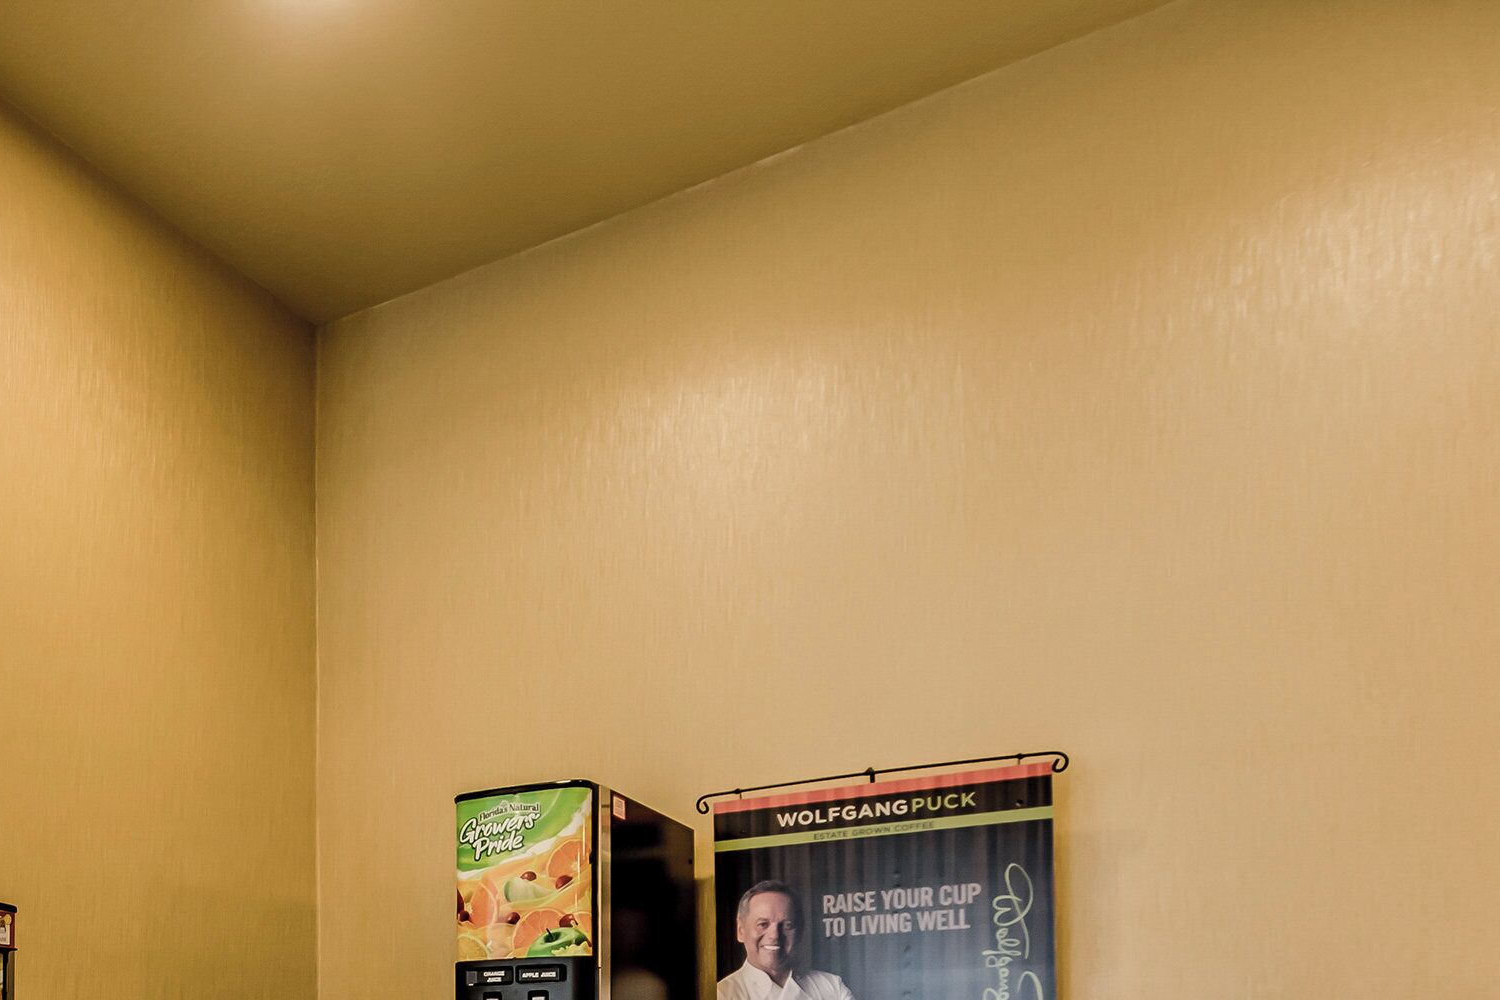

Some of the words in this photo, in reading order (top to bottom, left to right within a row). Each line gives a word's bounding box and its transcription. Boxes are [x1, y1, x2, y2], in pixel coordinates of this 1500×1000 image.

[509, 802, 541, 814] Natural
[473, 830, 525, 862] Pride
[813, 830, 849, 842] ESTATE
[851, 826, 891, 837] GROWN
[894, 821, 935, 832] COFFEE
[822, 890, 877, 914] RAISE
[880, 886, 934, 911] YOUR
[938, 882, 982, 906] CUP
[822, 916, 846, 938] TO
[850, 912, 912, 937] LIVING
[916, 908, 971, 932] WELL
